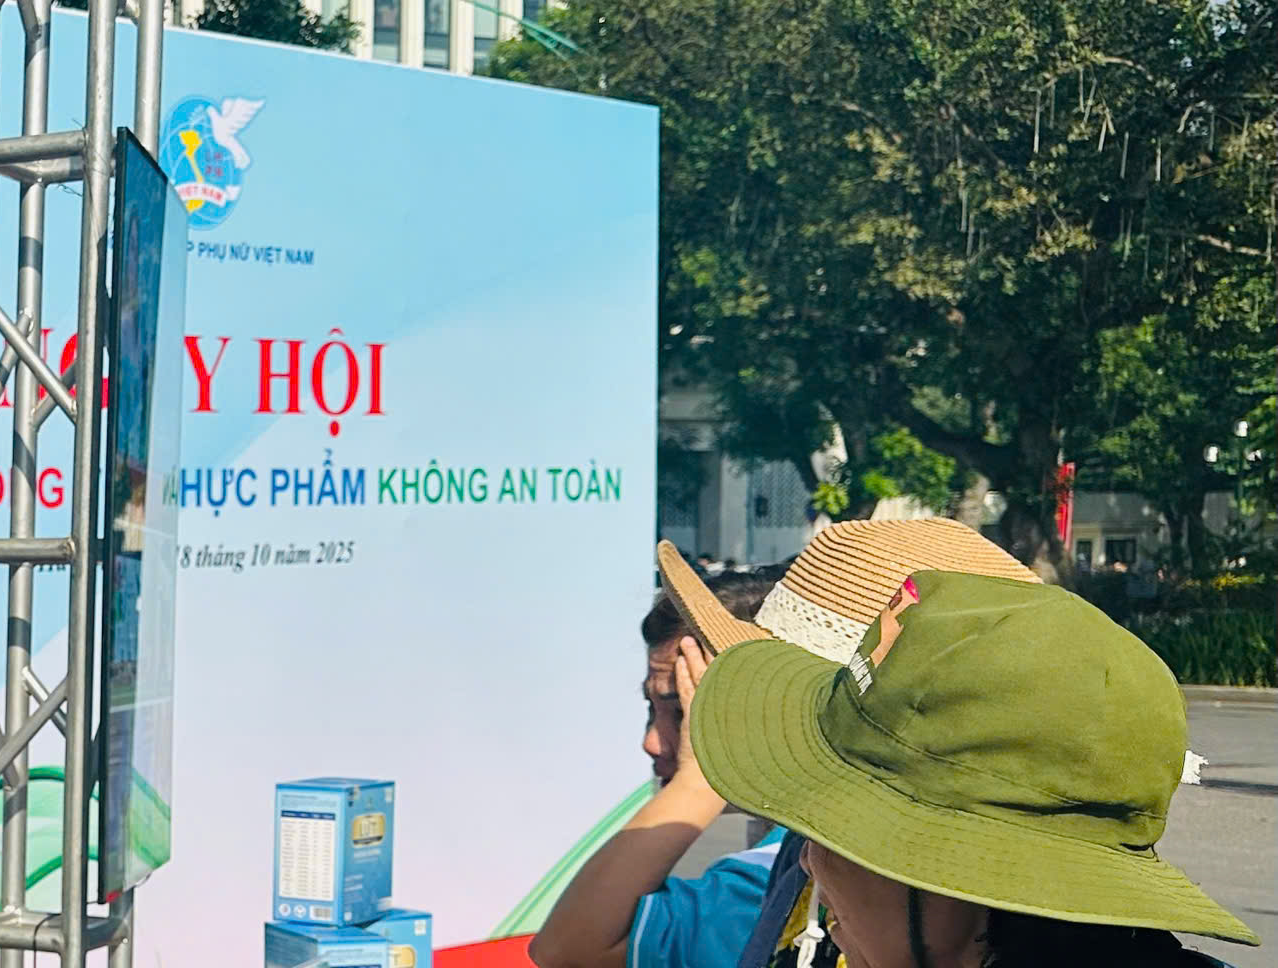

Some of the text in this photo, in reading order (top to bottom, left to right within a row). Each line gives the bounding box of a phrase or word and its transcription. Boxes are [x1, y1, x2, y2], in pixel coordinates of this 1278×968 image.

[198, 243, 227, 261] PHỤ
[230, 242, 249, 261] NỮ
[253, 246, 281, 266] VIỆT
[285, 250, 314, 265] NAM
[253, 328, 389, 437] HỘI
[181, 468, 257, 517] HỰC
[270, 449, 366, 508] PHẨM
[379, 459, 488, 504] KHÔNG
[498, 468, 538, 503] AN
[547, 459, 622, 502] TOÀN
[195, 542, 245, 573] tháng
[250, 543, 270, 566] 10
[275, 543, 311, 565] năm
[315, 541, 354, 564] 2025
